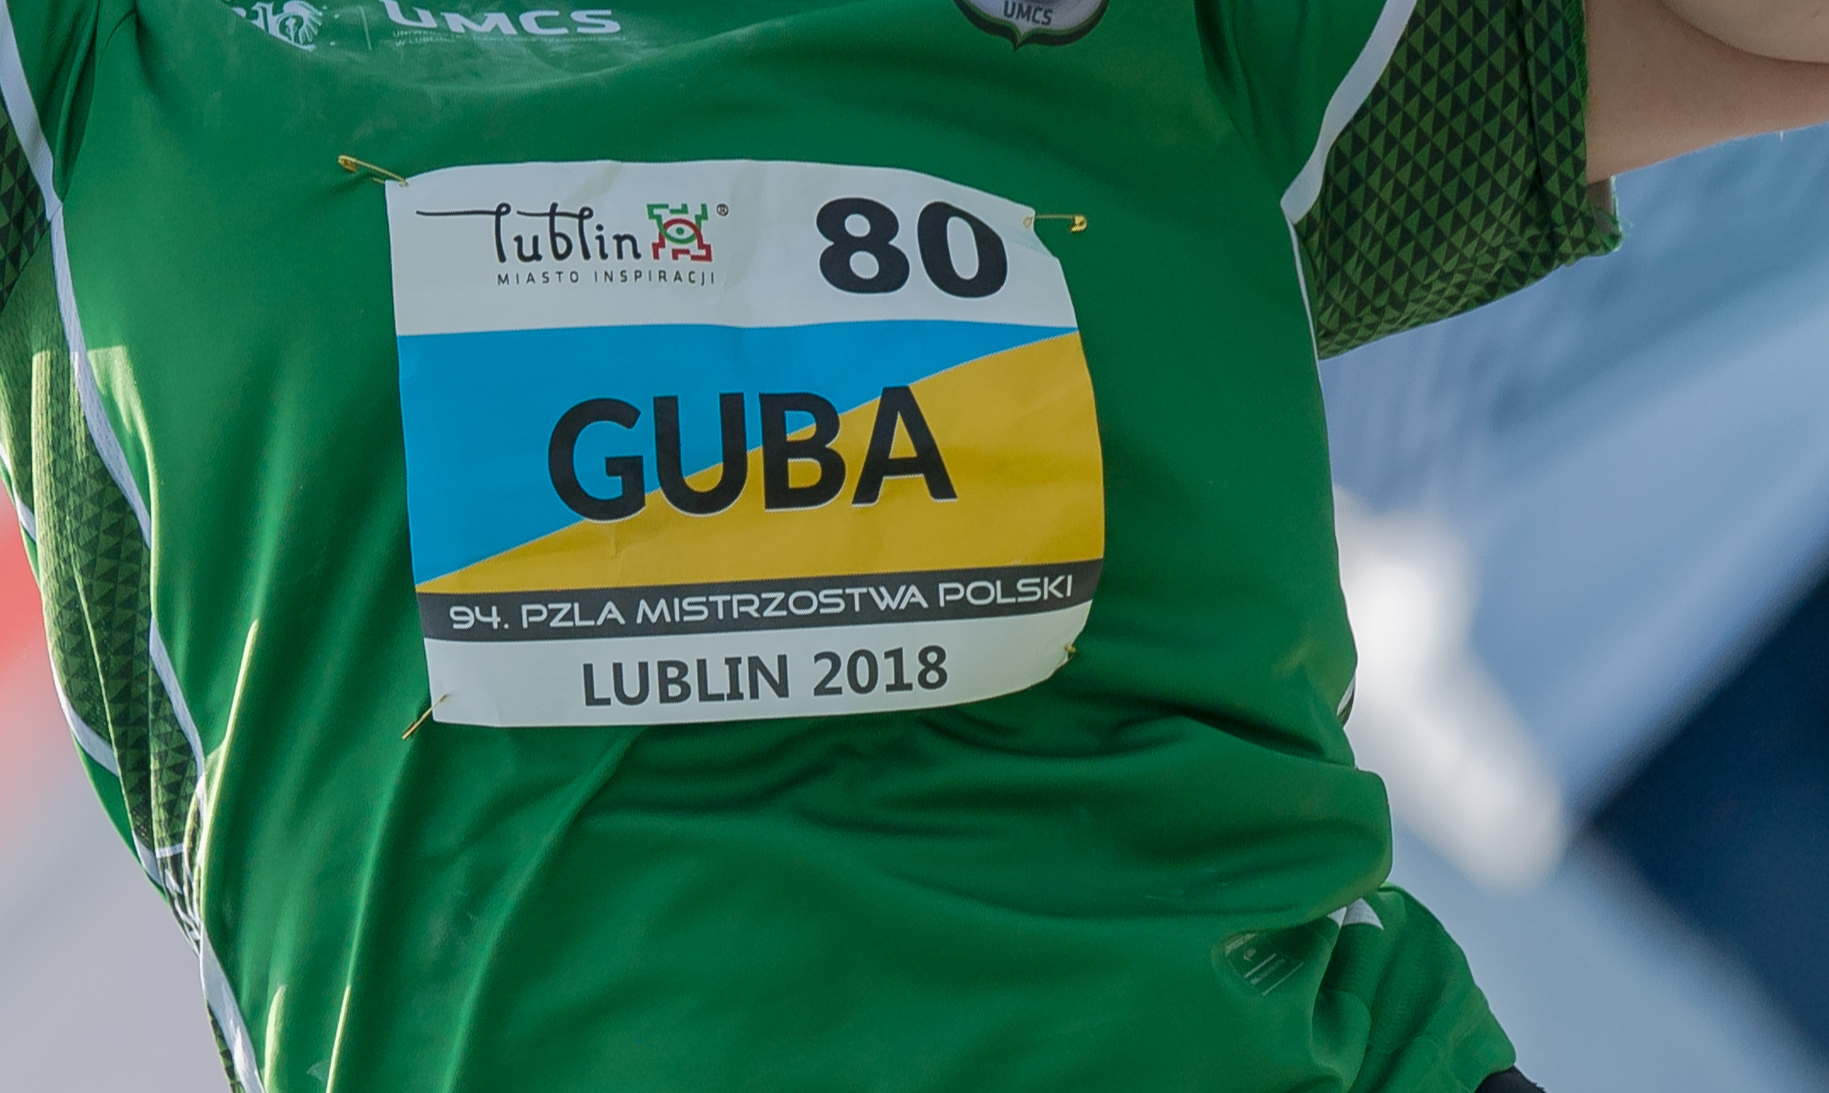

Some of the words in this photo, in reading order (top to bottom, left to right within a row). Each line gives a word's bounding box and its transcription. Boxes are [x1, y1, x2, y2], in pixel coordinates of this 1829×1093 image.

[1003, 0, 1054, 27] UMCS
[815, 196, 1009, 298] 80
[497, 269, 580, 286] MIASTO
[593, 269, 715, 286] INSPIRACJI
[546, 384, 959, 524] GUBA
[448, 604, 510, 630] 94.
[521, 599, 627, 629] PZLA
[635, 584, 930, 625] MISTRZOSTWA
[937, 574, 1074, 608] POLSKI
[582, 653, 790, 707] LUBLIN
[812, 644, 949, 697] 2018
